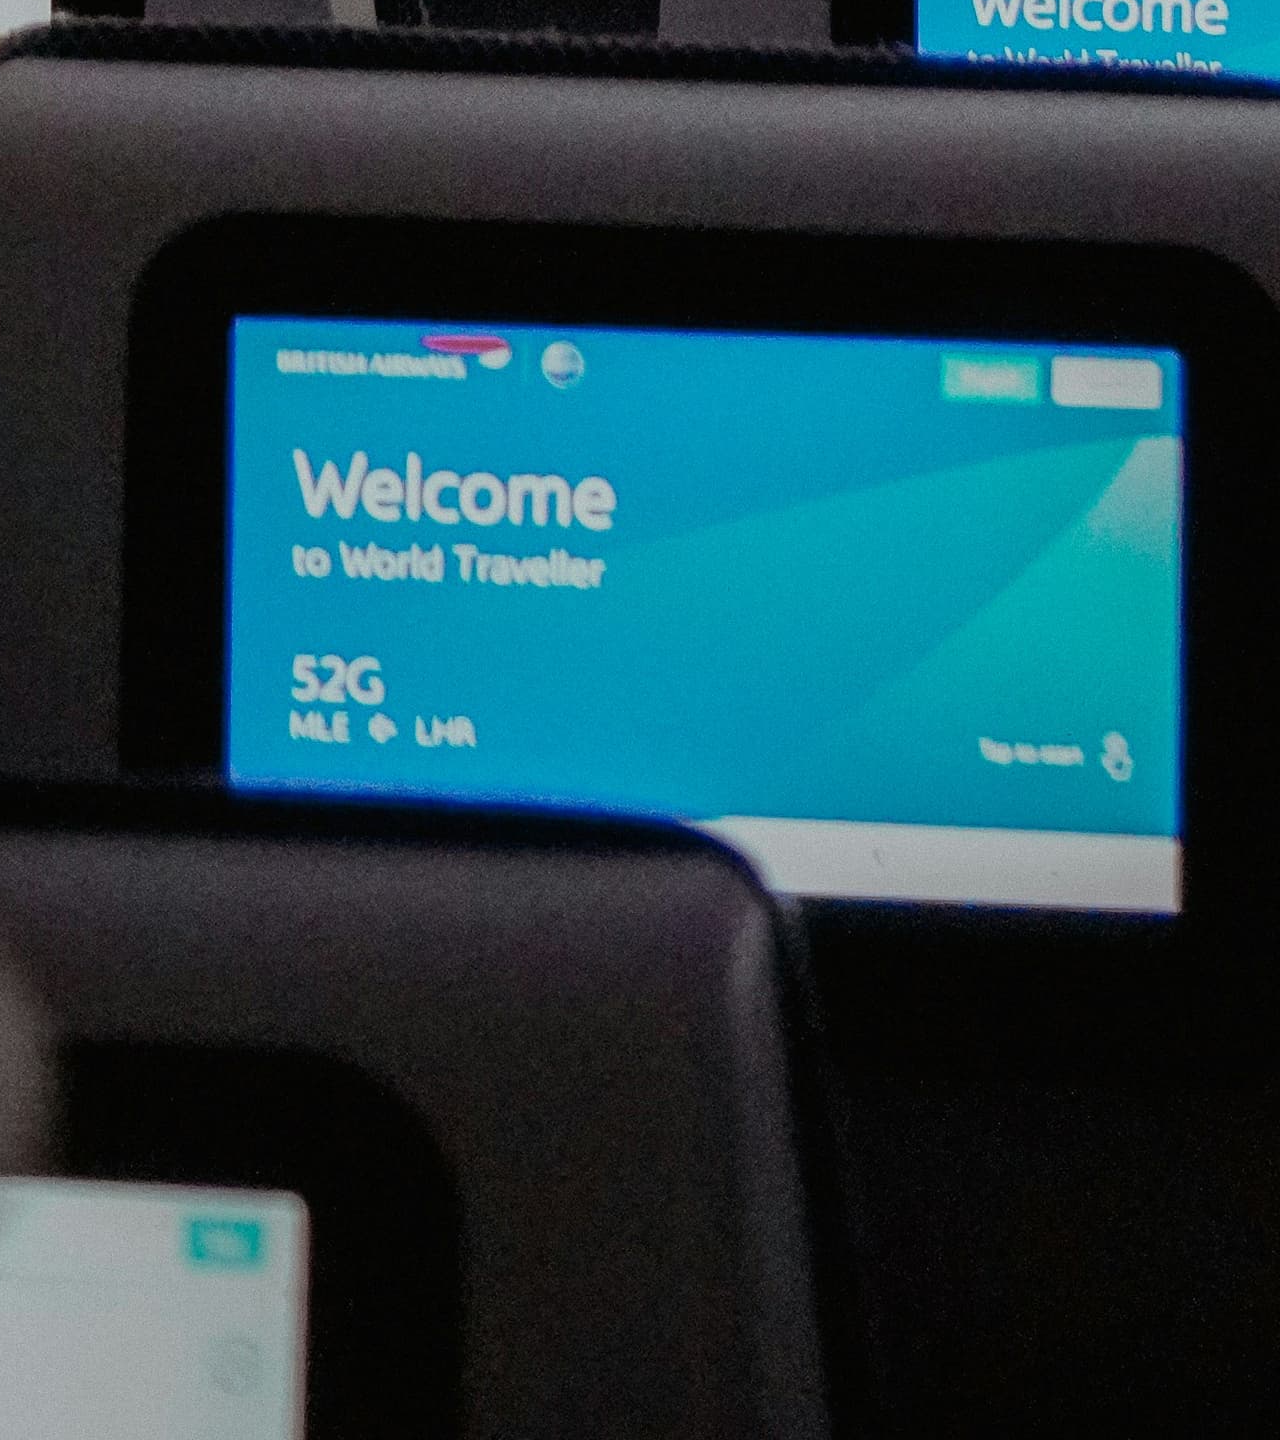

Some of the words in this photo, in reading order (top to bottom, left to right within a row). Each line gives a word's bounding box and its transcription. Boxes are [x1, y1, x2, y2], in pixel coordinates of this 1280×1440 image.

[293, 448, 617, 531] Welcome
[292, 544, 332, 578] to
[339, 540, 445, 582] World
[452, 542, 607, 589] Traveller
[291, 653, 386, 705] 52G
